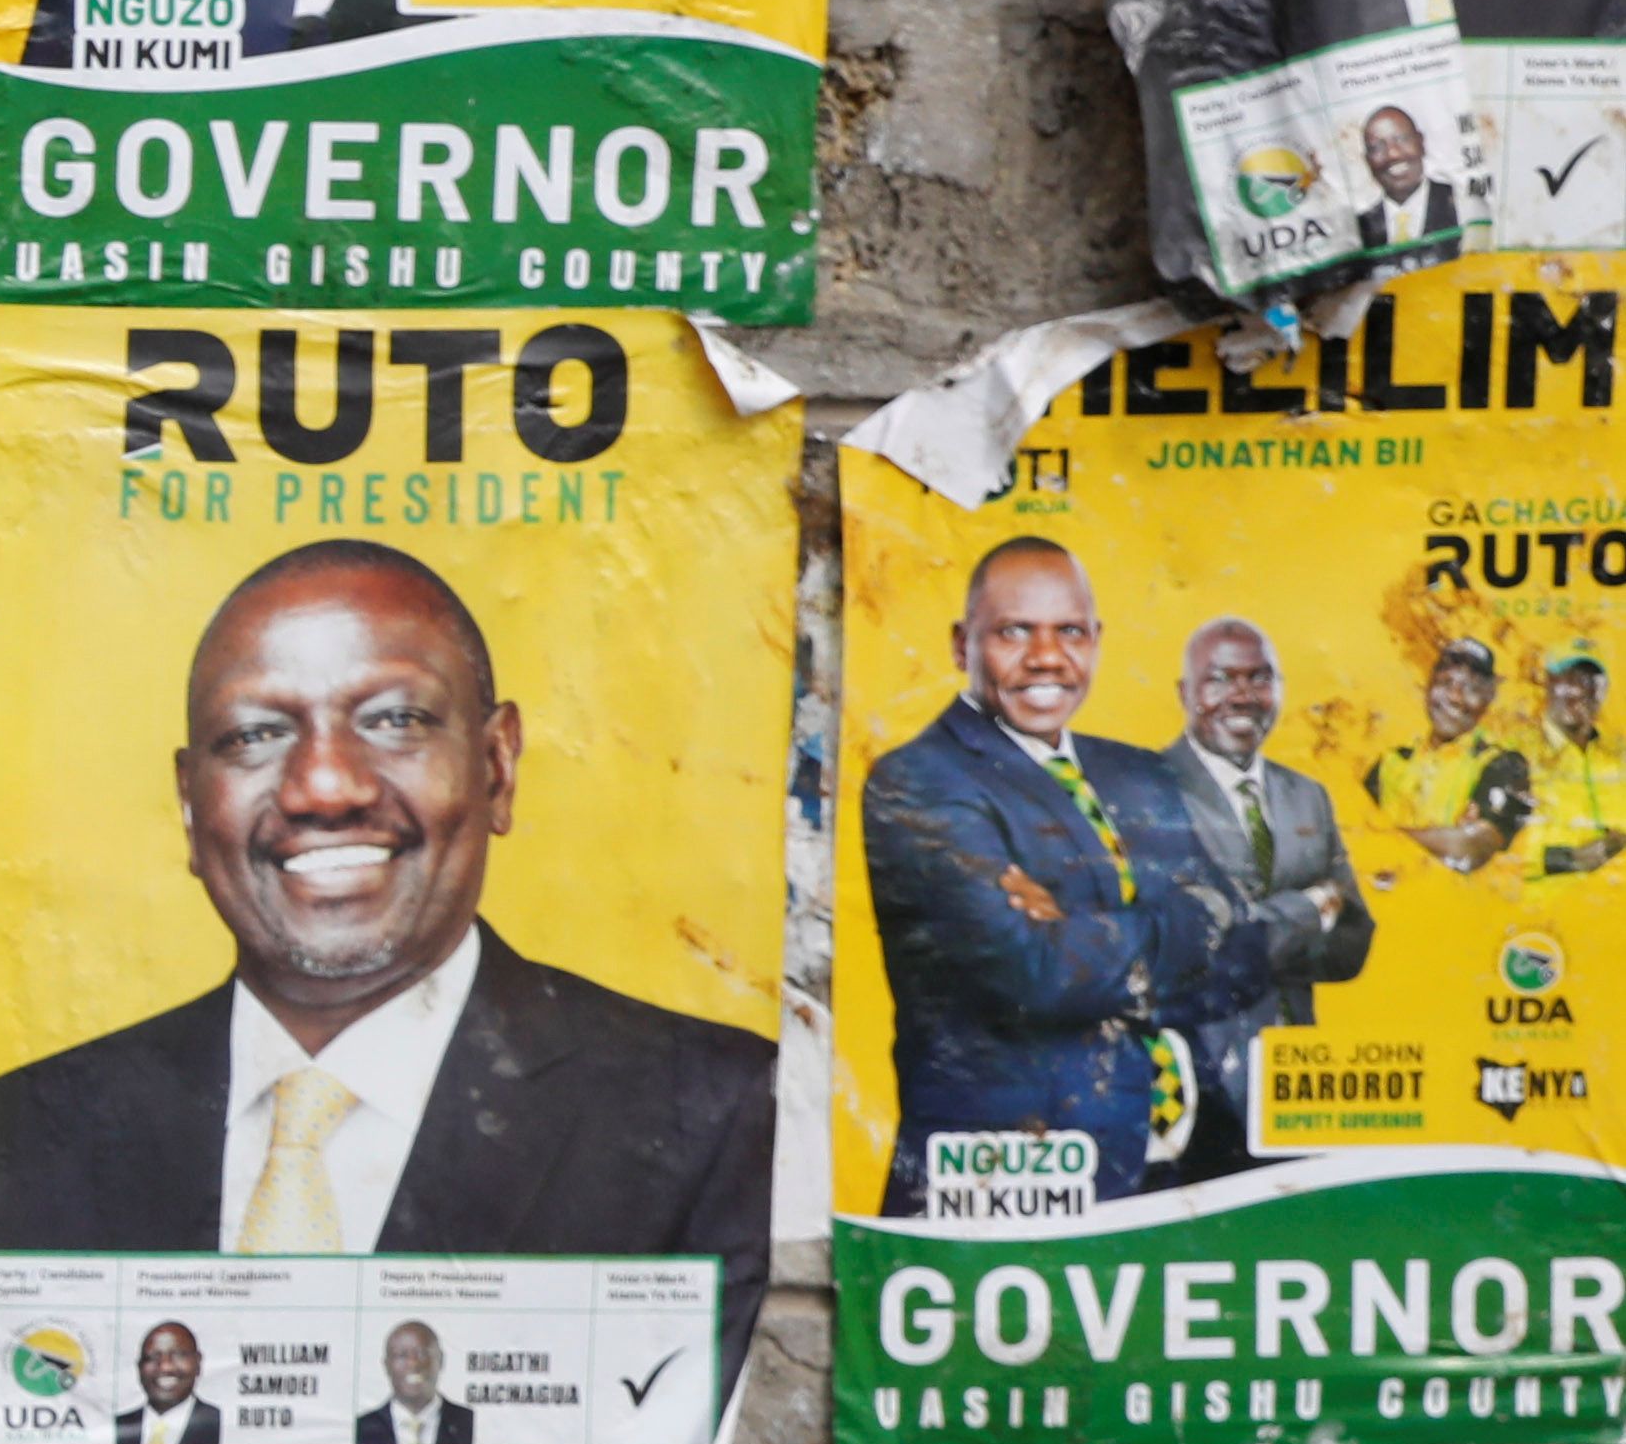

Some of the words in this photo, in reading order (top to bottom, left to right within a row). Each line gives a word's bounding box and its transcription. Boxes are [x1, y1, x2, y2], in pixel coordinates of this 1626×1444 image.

[86, 38, 123, 71] NI
[136, 38, 231, 71] KUMI
[21, 118, 770, 228] GOVERNOR
[15, 242, 209, 282] UASIN
[123, 323, 629, 465] RUTO
[1147, 439, 1362, 470] JONATHAN
[1377, 438, 1424, 465] BII
[119, 469, 232, 522] FOR
[277, 471, 625, 525] PRESIDENT
[1487, 996, 1575, 1025] UDA
[1273, 1070, 1425, 1102] BAROROT
[936, 1142, 1085, 1177] NGUZO
[988, 1186, 1085, 1217] KUMI
[880, 1257, 1626, 1367] GOVERNOR
[238, 1343, 329, 1366] WILLIAM
[4, 1406, 86, 1429] UDA
